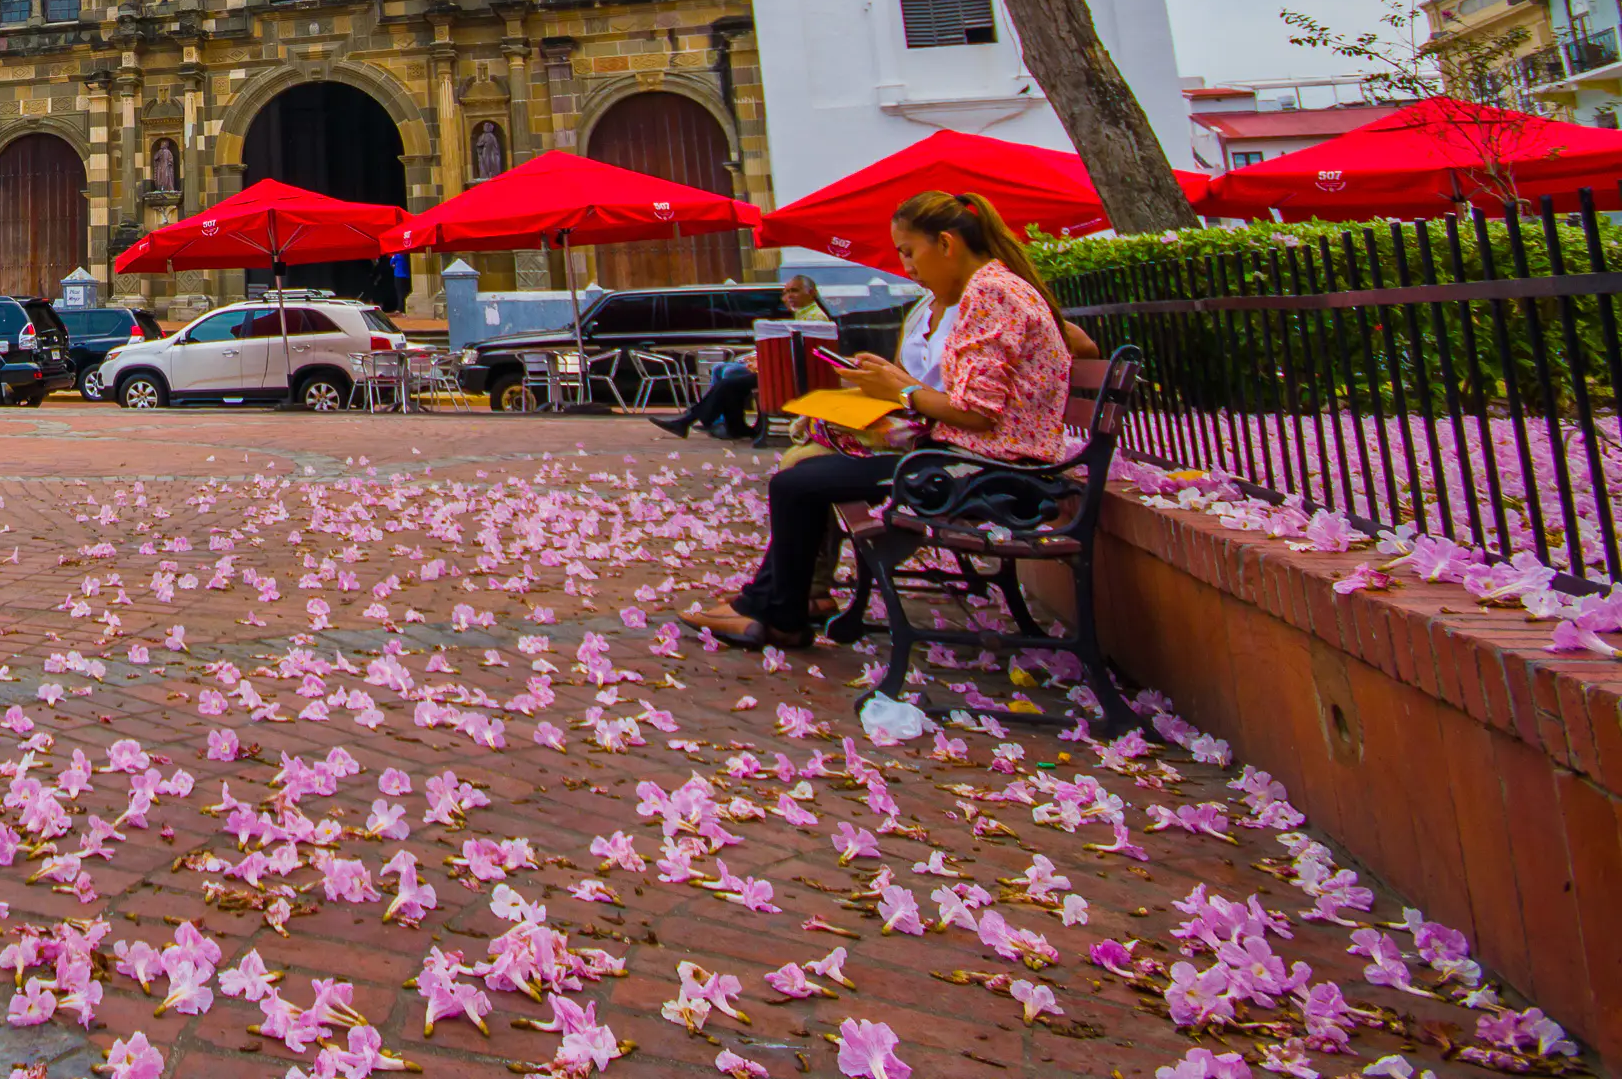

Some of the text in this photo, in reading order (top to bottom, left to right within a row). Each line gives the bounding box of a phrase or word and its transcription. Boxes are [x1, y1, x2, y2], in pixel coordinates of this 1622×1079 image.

[1318, 171, 1343, 180] 507
[203, 219, 217, 228] 507
[832, 236, 852, 249] 507
